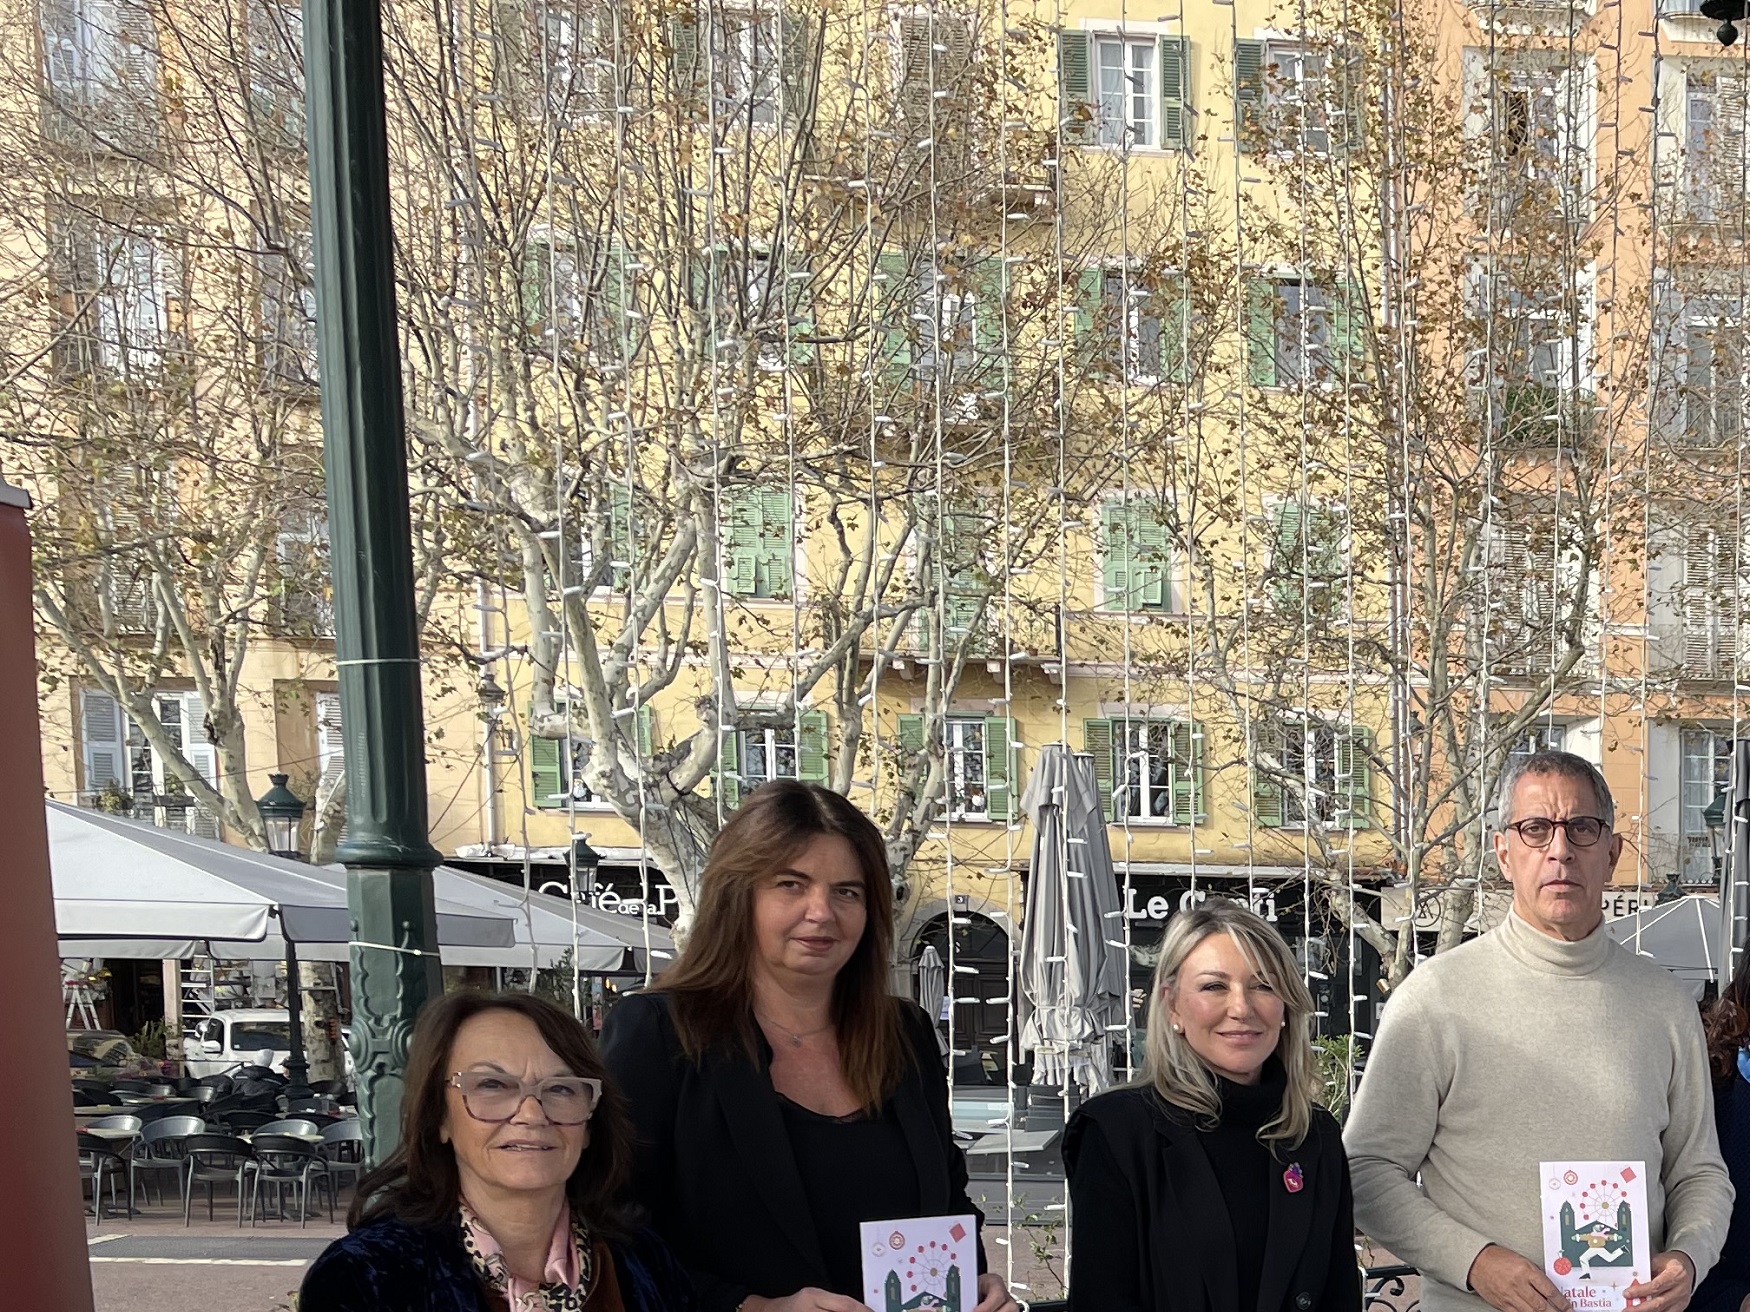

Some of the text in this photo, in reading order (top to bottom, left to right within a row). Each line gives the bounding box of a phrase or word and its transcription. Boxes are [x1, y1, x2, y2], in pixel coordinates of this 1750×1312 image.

[1126, 888, 1169, 920] Le
[1561, 1285, 1596, 1298] atale
[1580, 1298, 1612, 1308] Bastia
